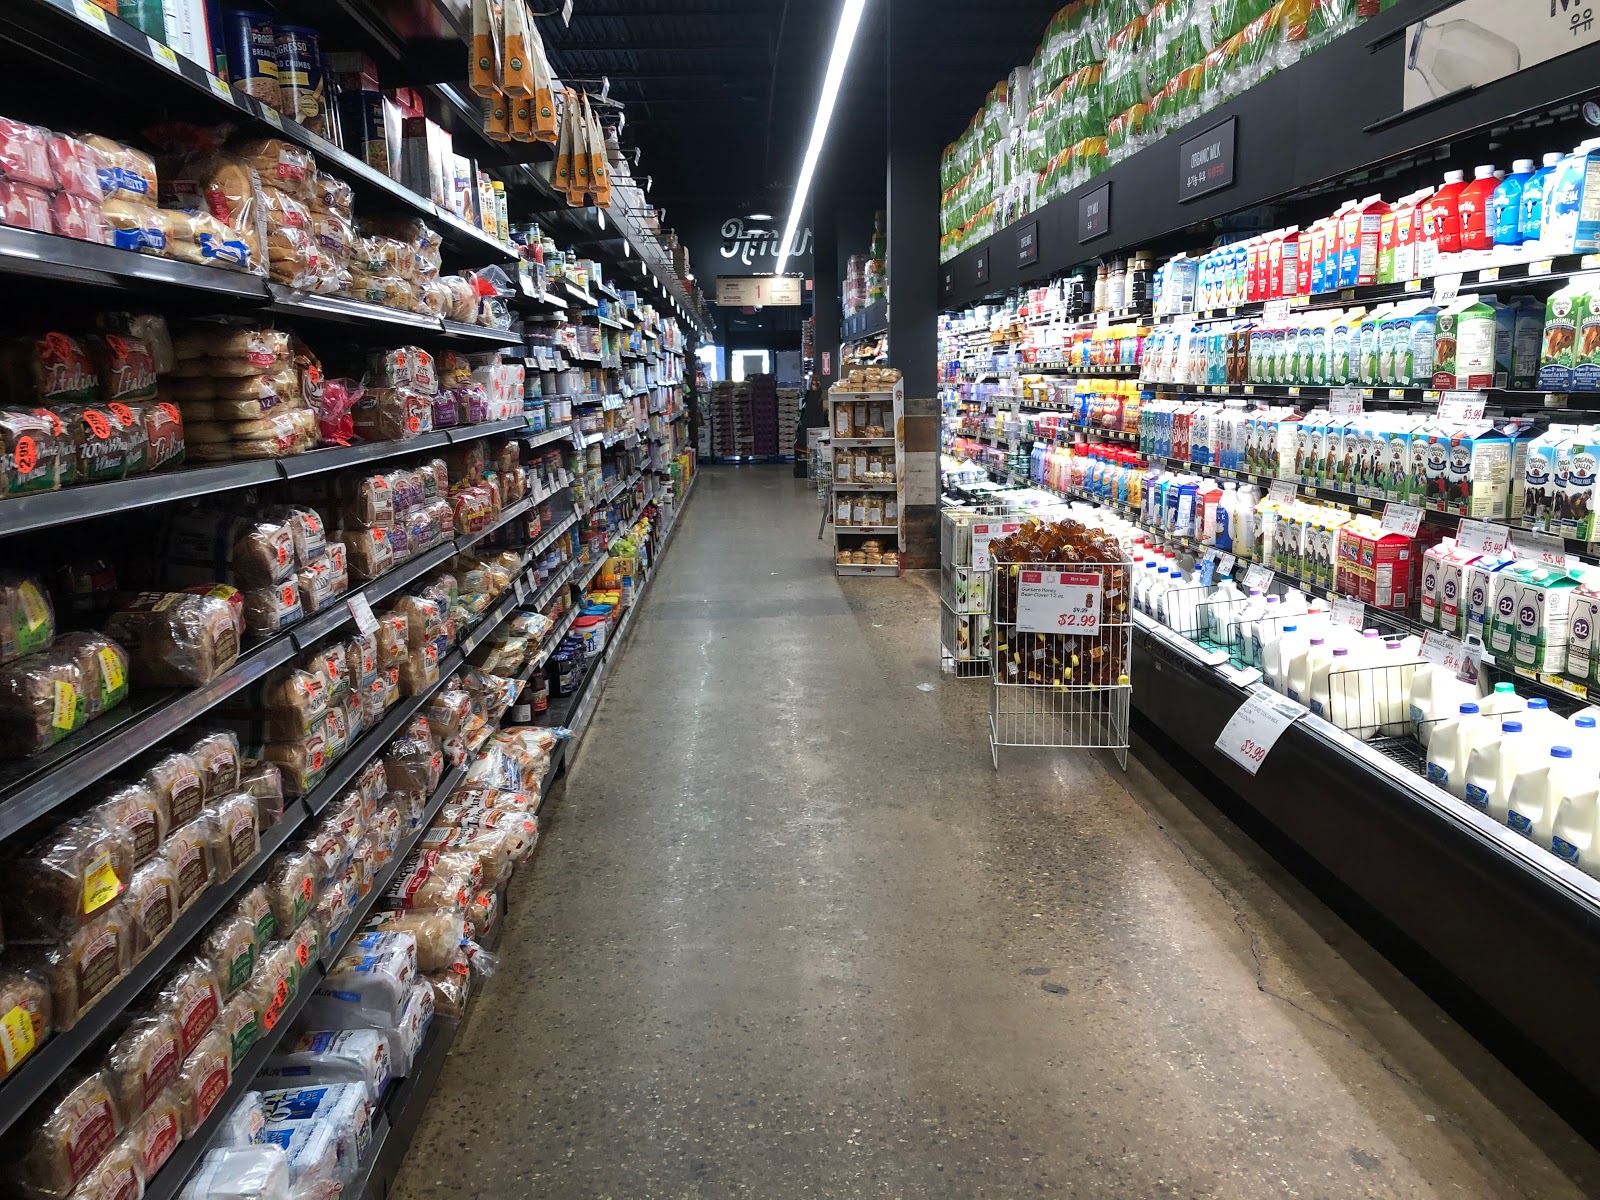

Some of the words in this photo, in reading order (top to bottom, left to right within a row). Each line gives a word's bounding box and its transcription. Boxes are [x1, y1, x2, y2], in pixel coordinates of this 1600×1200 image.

[1569, 8, 1594, 36] 우유
[252, 48, 270, 57] BREAD
[274, 43, 307, 55] OGRESSO
[285, 60, 311, 70] CRUMBS
[1191, 147, 1209, 169] ORGANIC
[1210, 141, 1221, 161] MILK
[279, 166, 285, 174] 8
[1545, 318, 1575, 326] GRASSMILK
[1583, 315, 1600, 324] GRASSM
[396, 368, 408, 377] RYE
[45, 362, 99, 397] Italian
[110, 365, 157, 399] Italian
[1463, 409, 1482, 420] $5.99
[150, 432, 186, 471] Italian
[1529, 457, 1547, 465] ORGANIC
[1573, 456, 1595, 467] ORGANIC
[1574, 463, 1592, 471] VALLEY
[1482, 541, 1503, 554] $5.49
[1543, 552, 1565, 566] $5.49
[1426, 577, 1434, 588] a2
[1445, 584, 1455, 596] a2
[1473, 590, 1483, 603] a2
[1500, 600, 1512, 613] a2
[1058, 613, 1096, 627] $2.99
[1521, 609, 1534, 623] a2
[1574, 622, 1588, 636] a2
[1240, 739, 1265, 762] $3.99
